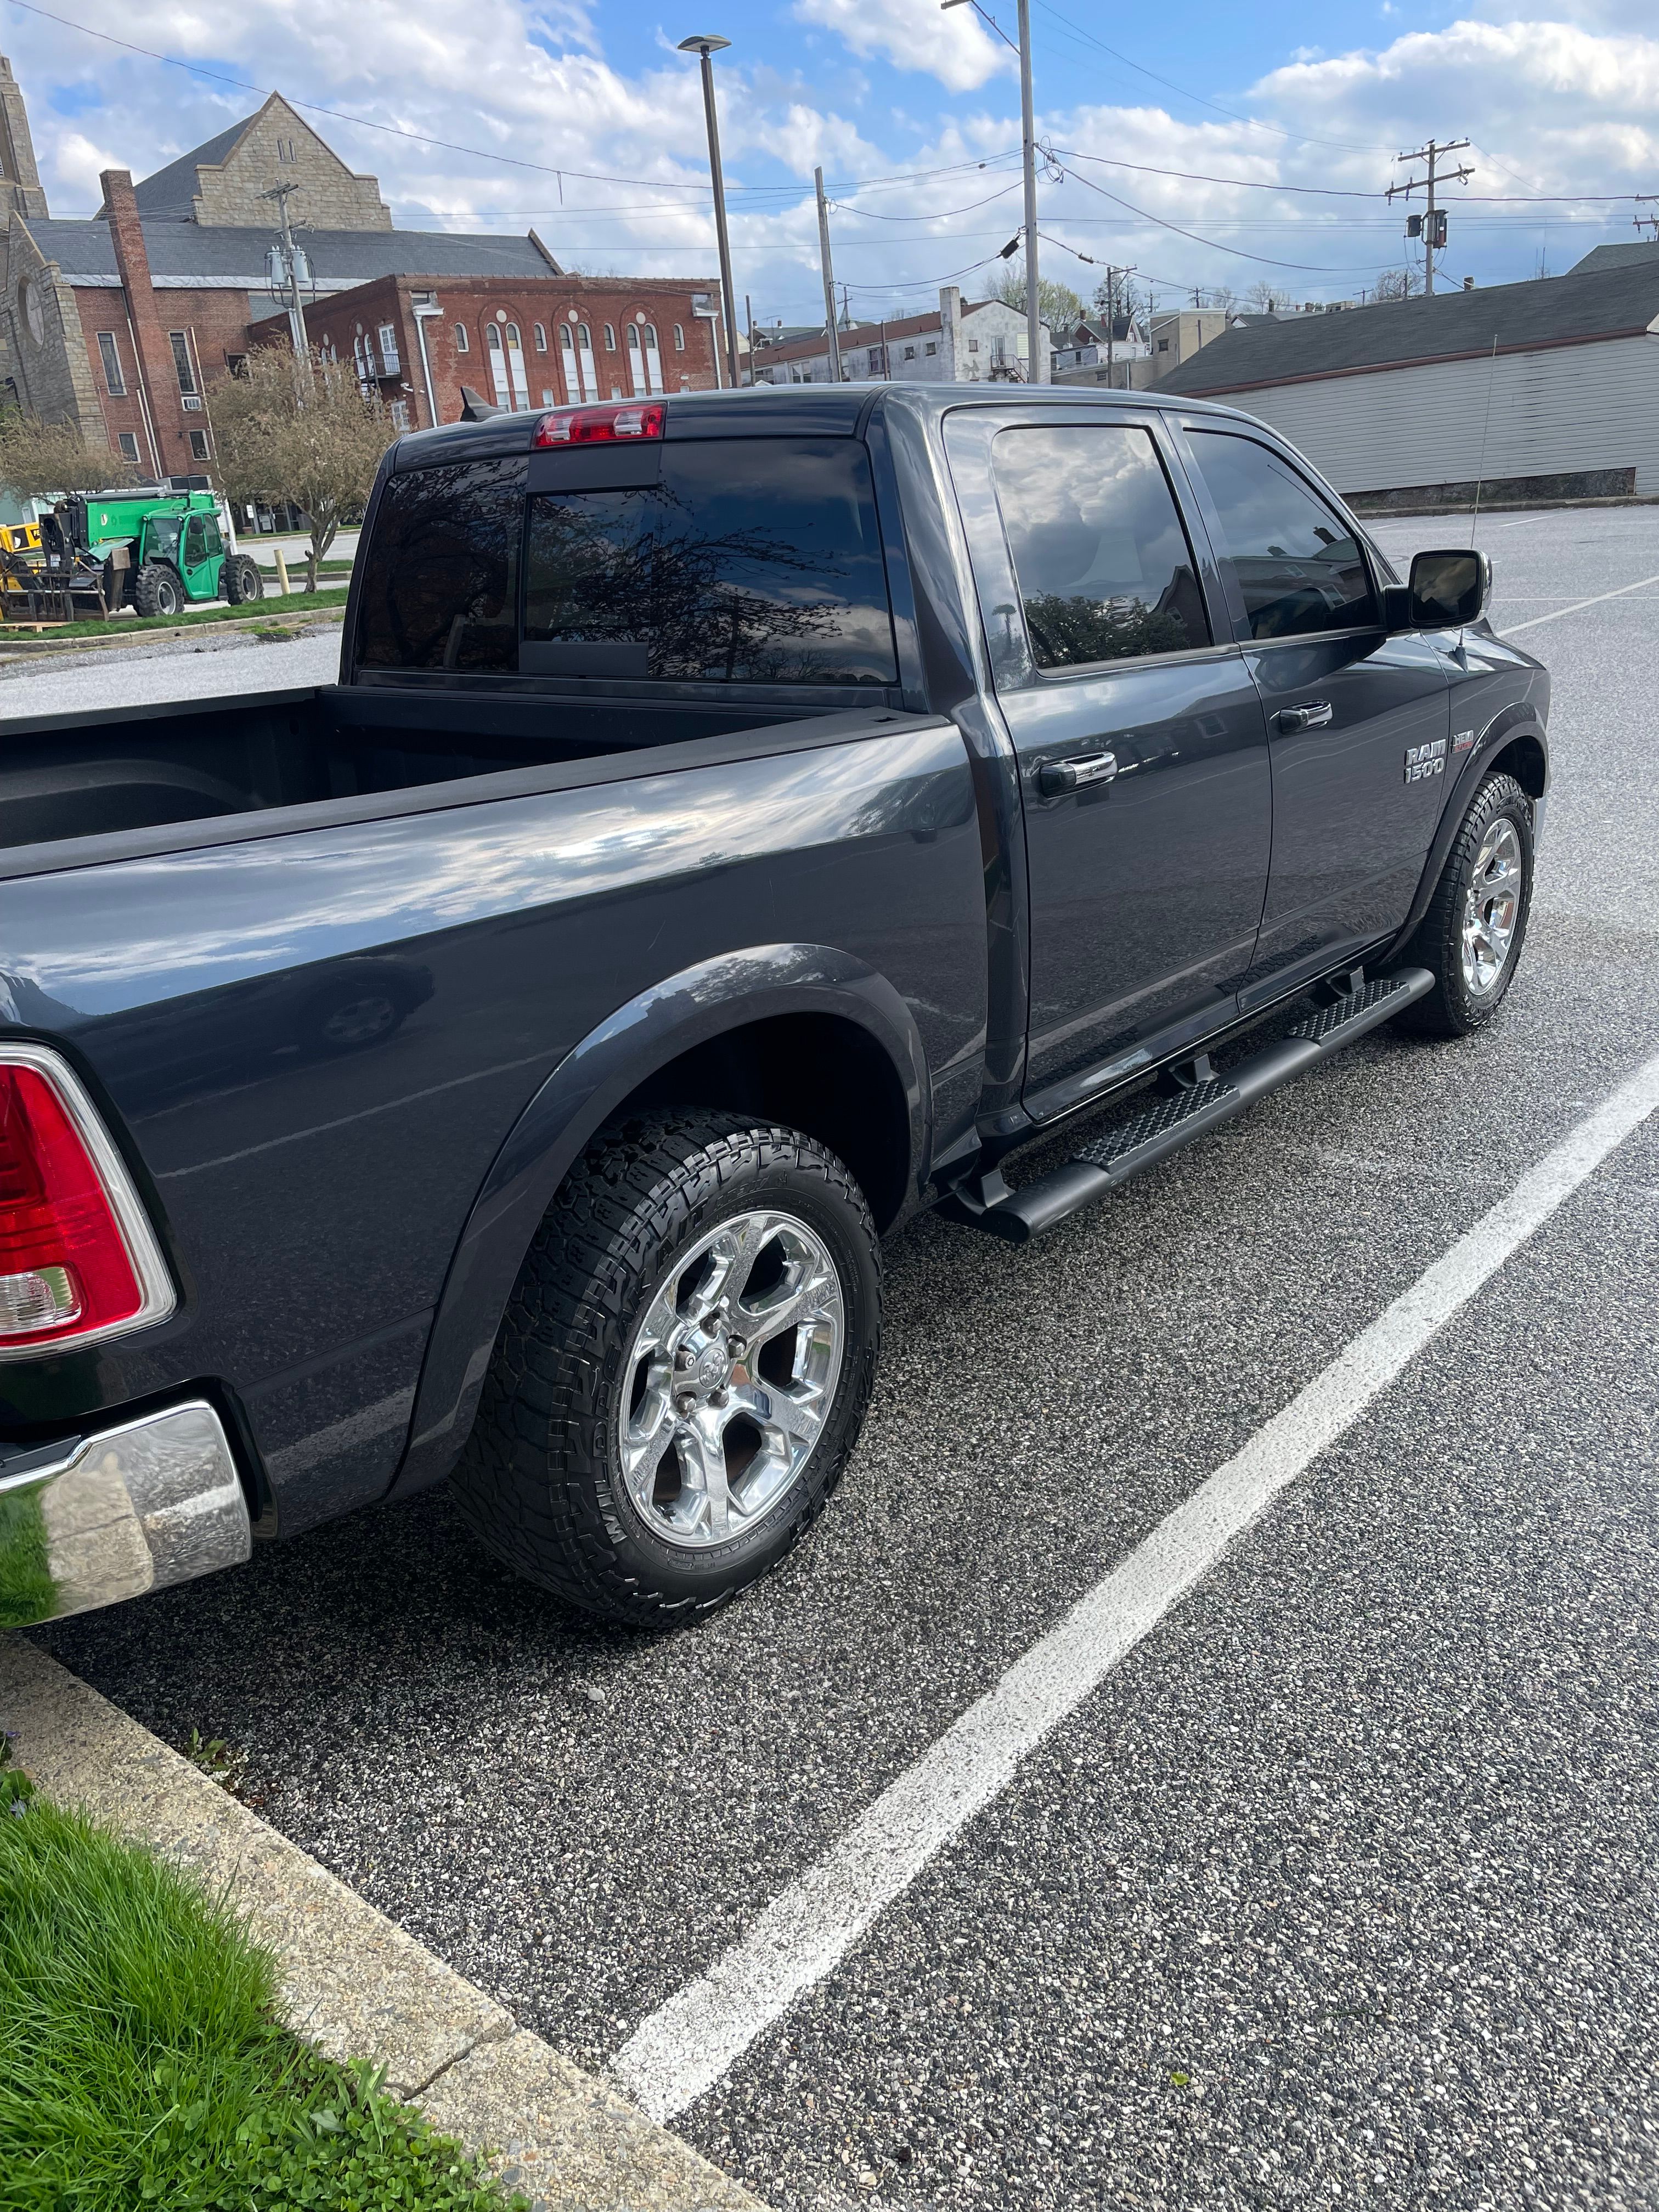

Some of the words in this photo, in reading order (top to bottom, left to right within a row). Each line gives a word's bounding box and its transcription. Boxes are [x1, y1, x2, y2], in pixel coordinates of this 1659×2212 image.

[1406, 738, 1446, 766] RAM
[1453, 730, 1474, 746] HEMI
[1404, 757, 1444, 785] 1500
